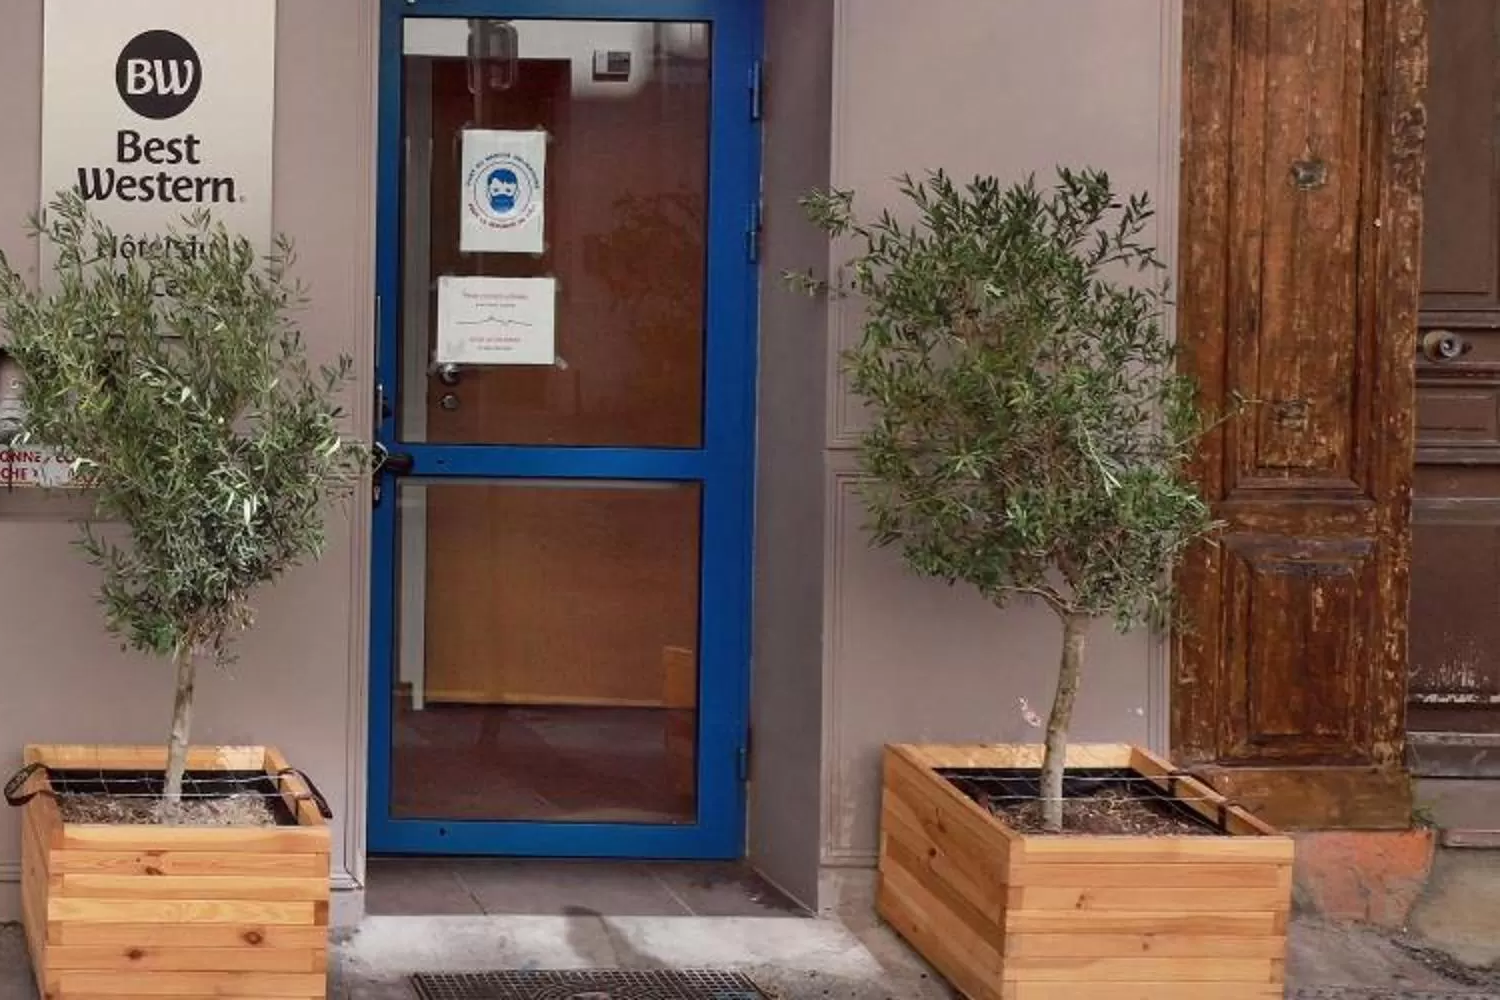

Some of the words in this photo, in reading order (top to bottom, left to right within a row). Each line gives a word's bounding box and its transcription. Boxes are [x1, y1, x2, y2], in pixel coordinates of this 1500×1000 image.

[126, 58, 195, 96] BW
[116, 129, 201, 165] Best
[77, 166, 236, 203] Western
